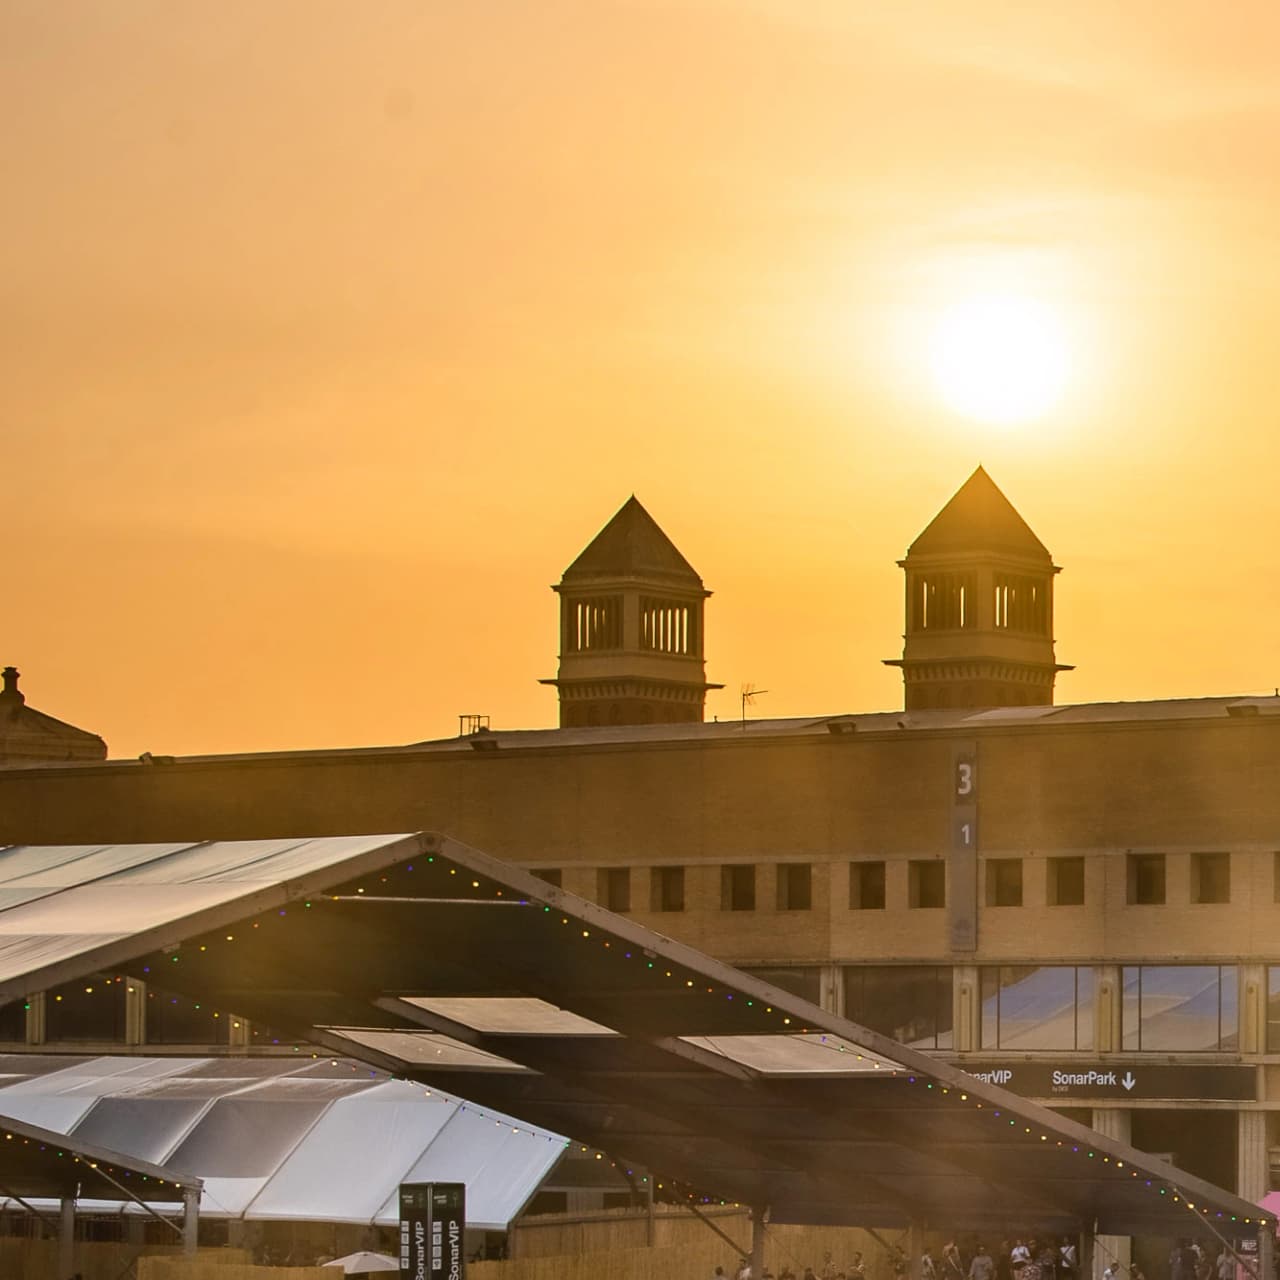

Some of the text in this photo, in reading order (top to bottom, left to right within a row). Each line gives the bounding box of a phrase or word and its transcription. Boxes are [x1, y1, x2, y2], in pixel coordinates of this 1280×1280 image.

[958, 764, 972, 795] 3
[961, 823, 970, 844] 1
[1052, 1070, 1117, 1085] SonarPark
